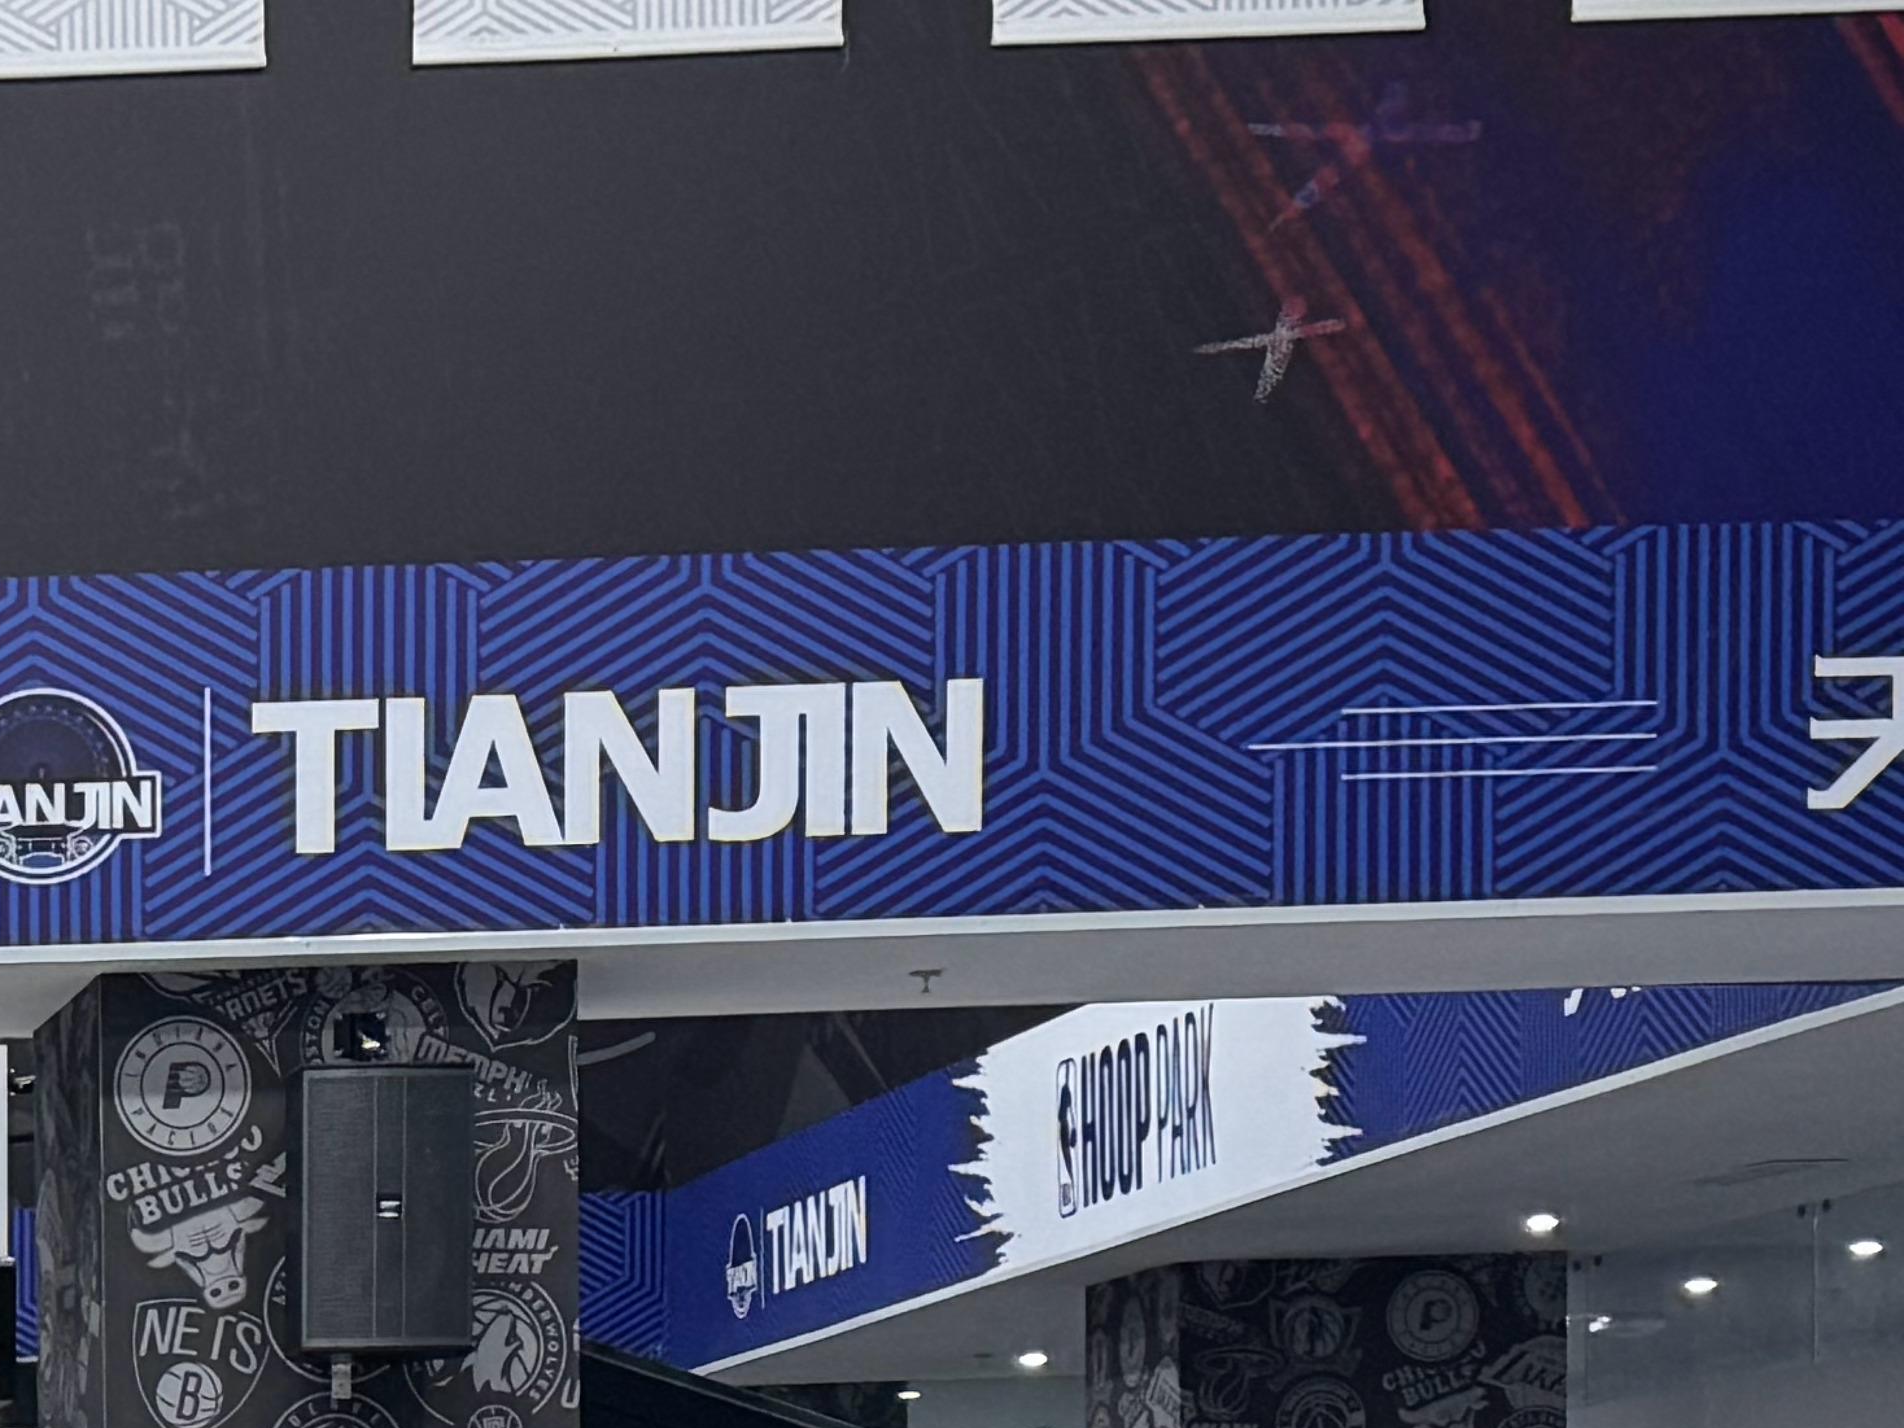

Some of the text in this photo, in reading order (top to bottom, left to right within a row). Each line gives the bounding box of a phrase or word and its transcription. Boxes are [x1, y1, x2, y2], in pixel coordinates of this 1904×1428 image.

[252, 678, 983, 854] TIANJIN
[213, 966, 308, 1020] RNETS
[1081, 1003, 1217, 1208] HOOP PARK
[473, 1228, 551, 1251] IAMI
[765, 1175, 868, 1295] TIANJIN
